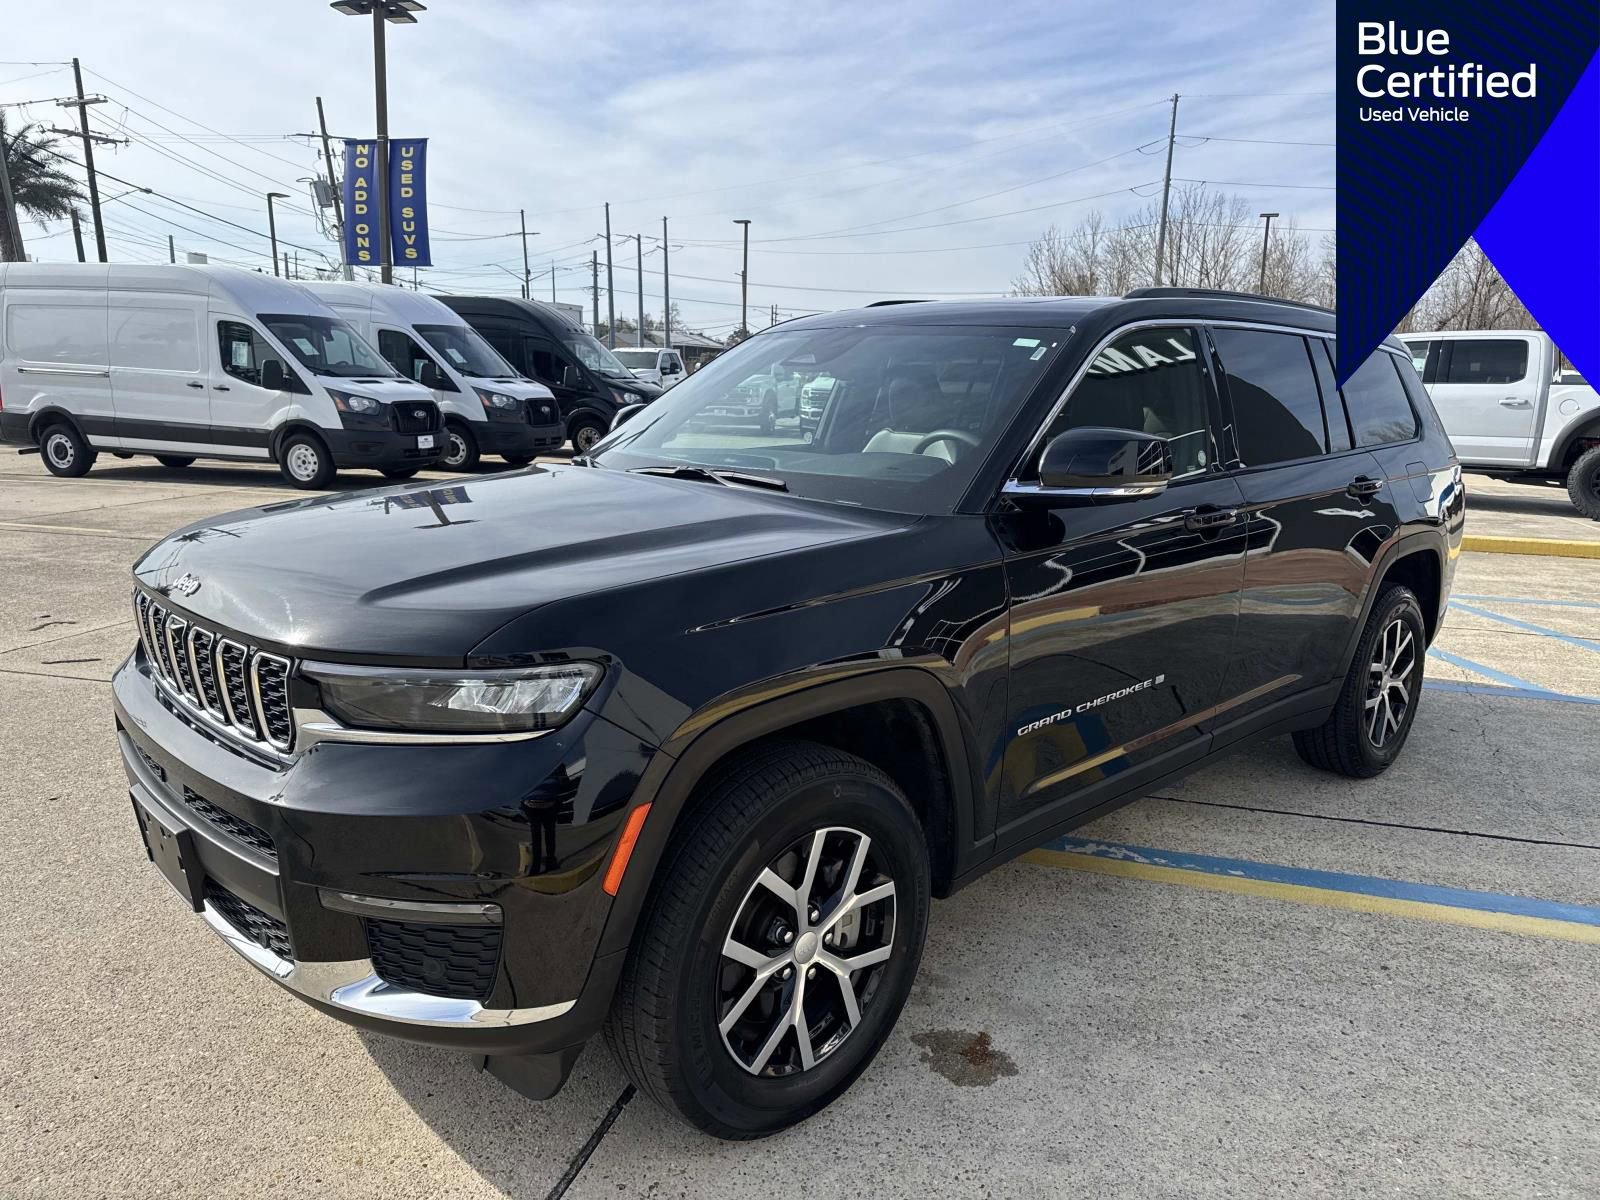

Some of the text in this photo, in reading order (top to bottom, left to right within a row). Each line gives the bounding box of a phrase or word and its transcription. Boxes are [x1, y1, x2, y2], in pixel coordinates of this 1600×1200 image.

[355, 144, 371, 262] NO ADD ONS
[400, 147, 418, 259] USED SUVS
[172, 571, 200, 597] Jeep
[1017, 678, 1153, 736] GRAND CHEROKEE
